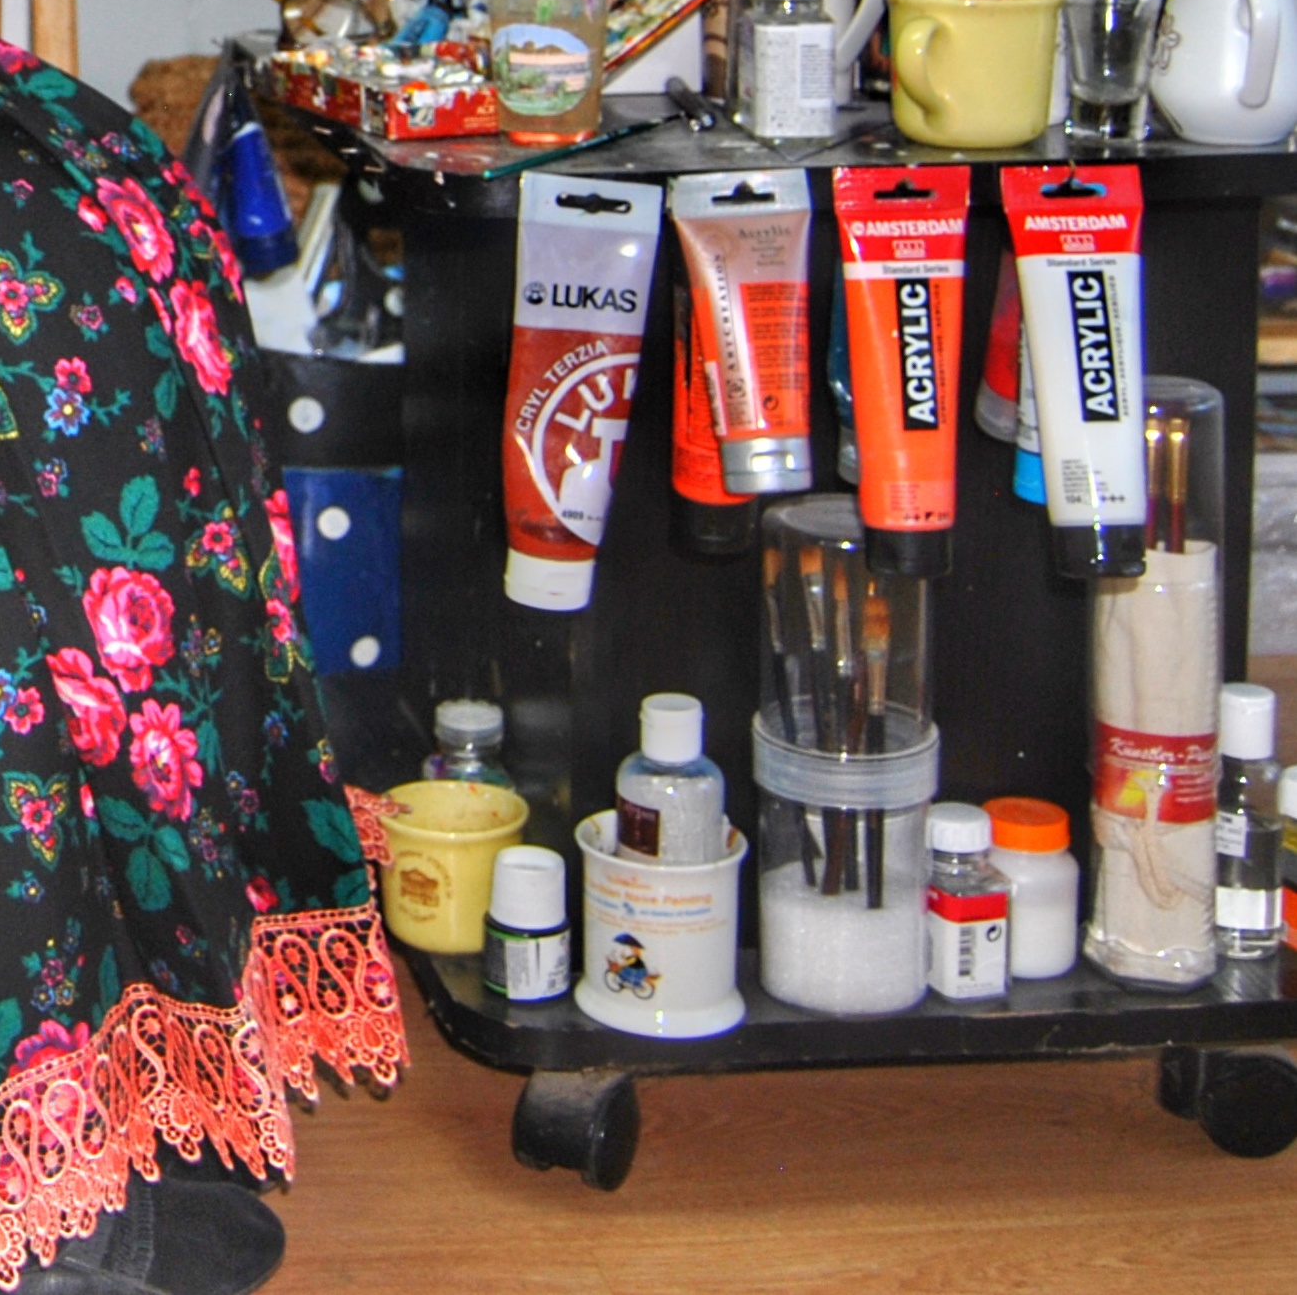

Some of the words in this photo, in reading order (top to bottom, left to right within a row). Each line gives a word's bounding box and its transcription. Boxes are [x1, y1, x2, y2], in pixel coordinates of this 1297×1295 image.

[865, 219, 966, 236] AMSTERDAM
[1024, 214, 1127, 231] AMSTERDAM
[882, 263, 921, 275] Standard
[923, 262, 950, 274] Series
[1046, 257, 1087, 267] Standard
[1089, 257, 1117, 267] Series
[552, 283, 638, 313] LUKAS
[900, 283, 938, 424] ACRYLIC
[1072, 276, 1117, 416] ACRYLIC
[543, 339, 609, 383] TERZIA
